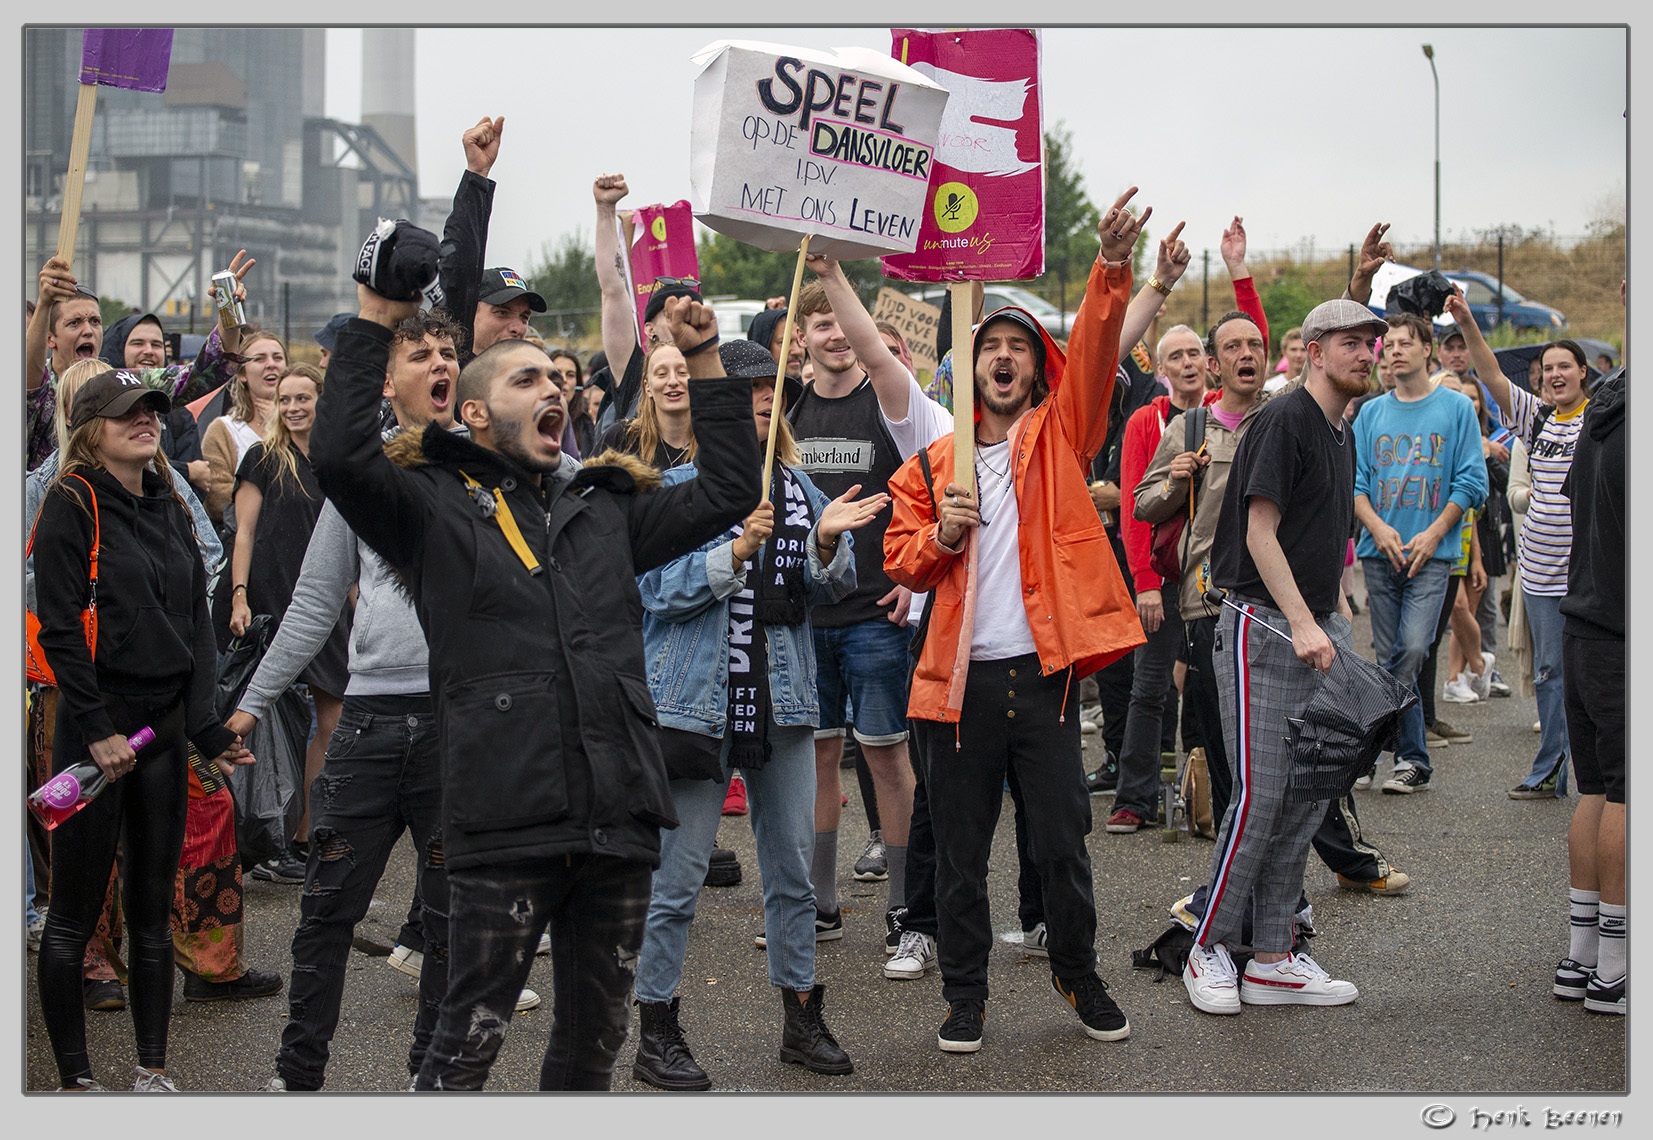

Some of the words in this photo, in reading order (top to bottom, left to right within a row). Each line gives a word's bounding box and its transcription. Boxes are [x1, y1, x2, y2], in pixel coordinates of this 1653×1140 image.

[756, 56, 904, 136] SPEEL
[743, 115, 770, 150] OP
[771, 120, 798, 150] DE
[812, 121, 929, 179] DANSVLOER
[741, 183, 788, 216] MET
[800, 196, 836, 226] ONS
[850, 198, 915, 239] LEVEN
[360, 244, 375, 277] FACE
[882, 294, 906, 314] TIJD
[876, 310, 932, 339] ACTIEVE
[906, 337, 938, 362] NERIN
[800, 447, 861, 465] mberland
[1375, 432, 1446, 467] GOLF
[1532, 439, 1576, 459] NIPE
[1376, 475, 1441, 511] OPEN
[777, 538, 804, 553] DRI
